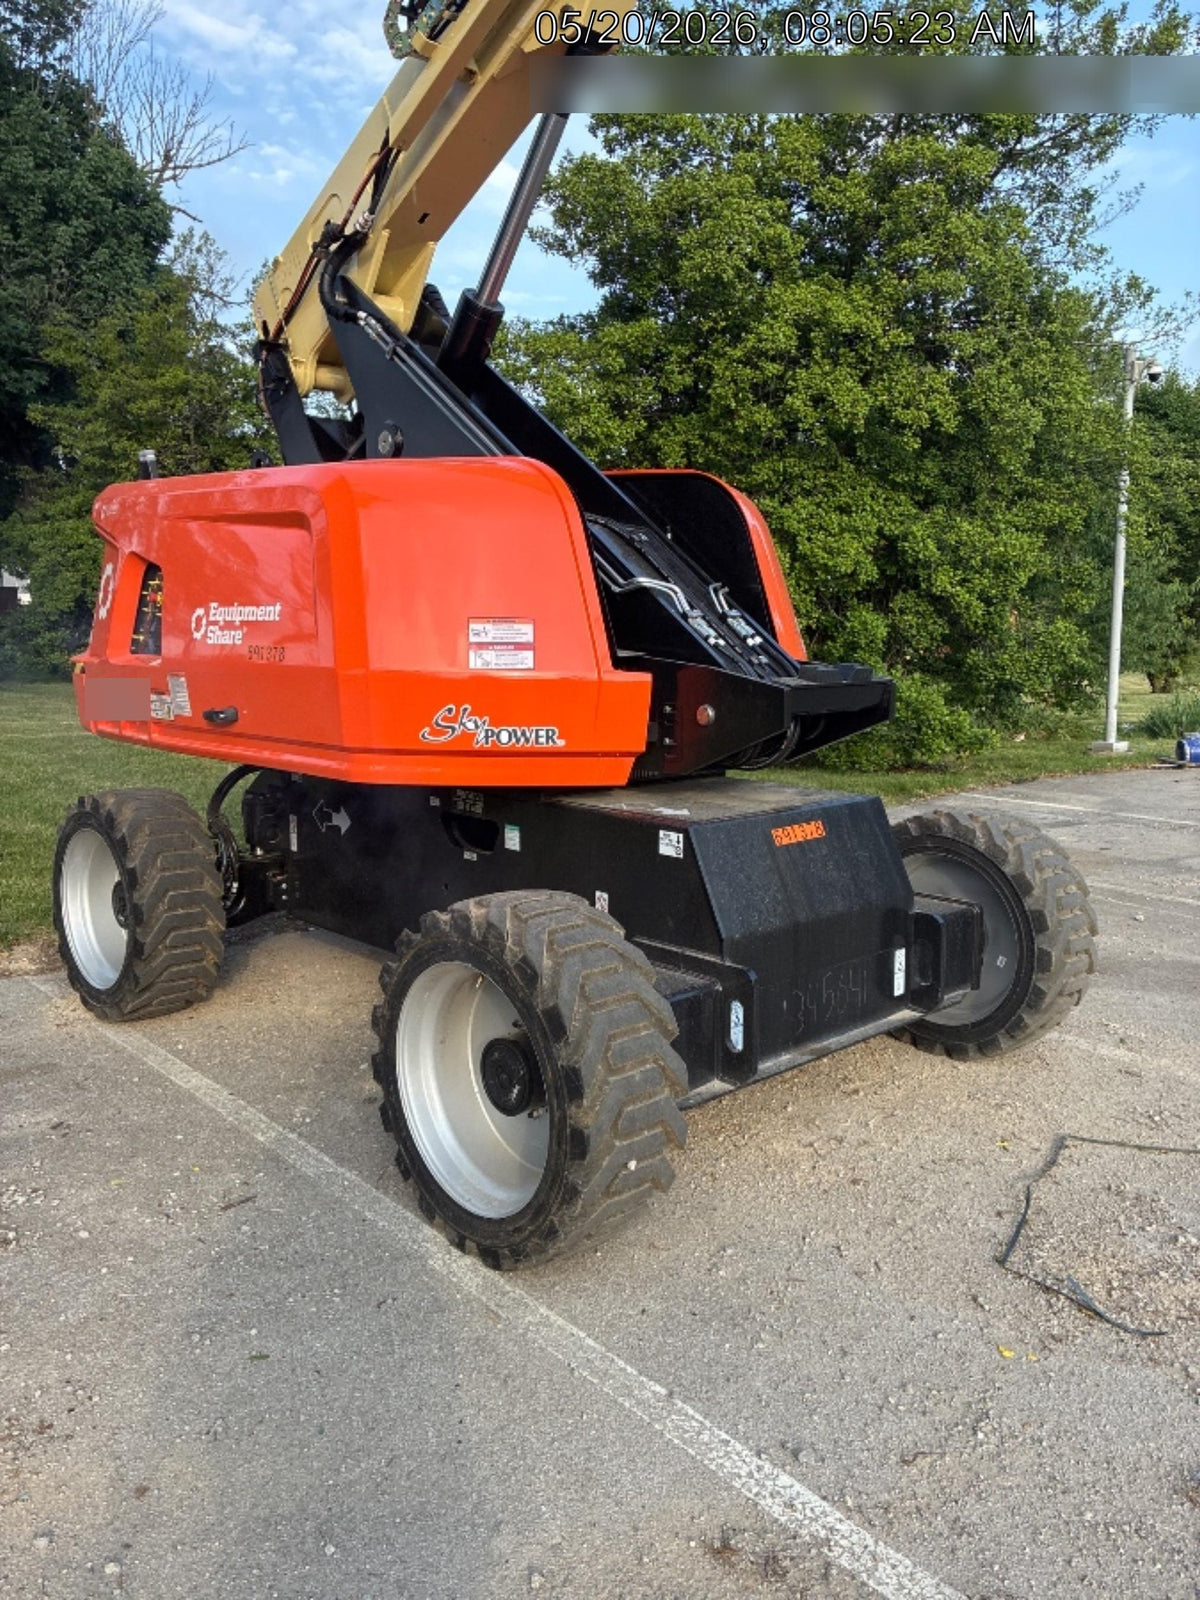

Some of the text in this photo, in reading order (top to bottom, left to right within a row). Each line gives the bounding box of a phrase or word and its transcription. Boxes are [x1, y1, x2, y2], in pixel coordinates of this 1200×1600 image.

[208, 602, 281, 626] Equipment
[206, 625, 243, 645] Share
[419, 704, 560, 748] Sky POWER
